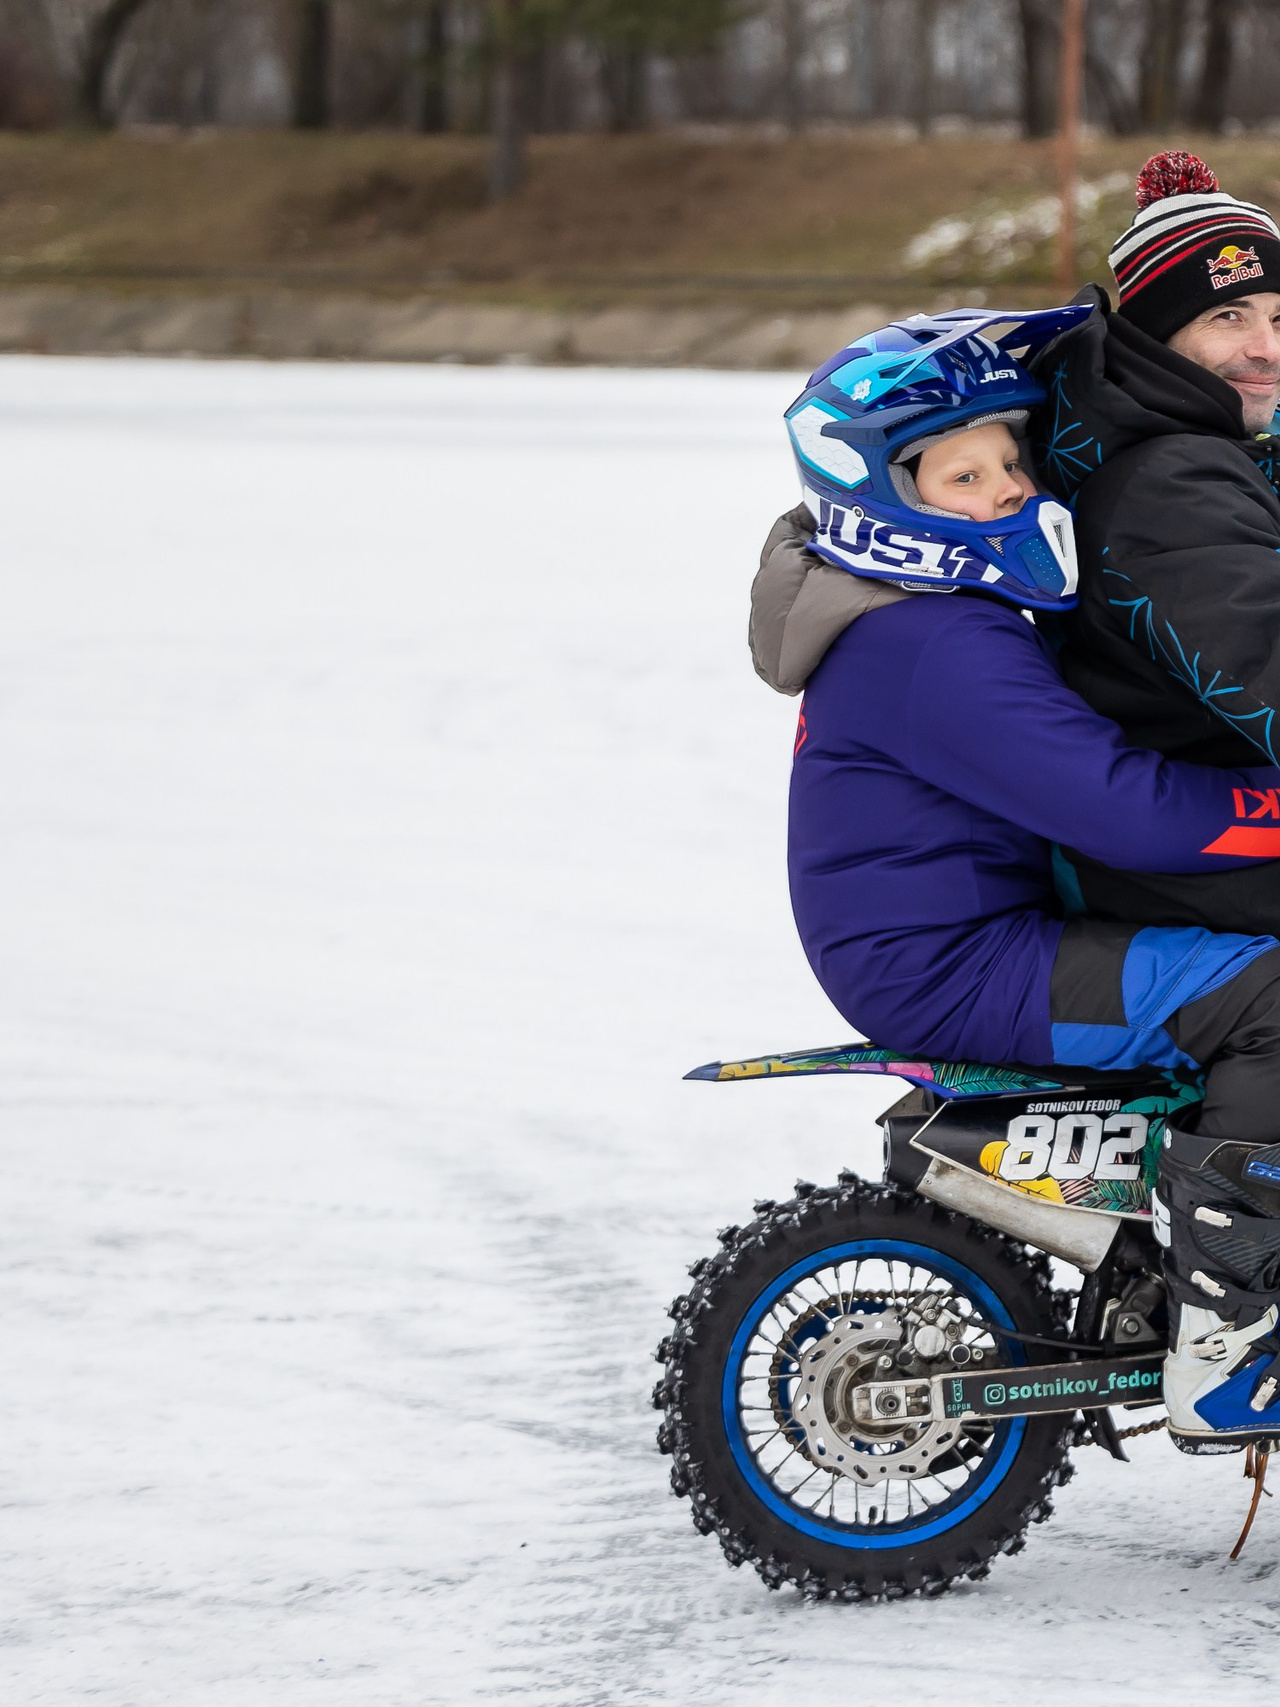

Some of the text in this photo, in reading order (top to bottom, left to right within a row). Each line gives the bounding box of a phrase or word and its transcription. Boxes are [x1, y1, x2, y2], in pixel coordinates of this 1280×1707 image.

[1211, 263, 1264, 289] Red Bull
[1026, 1099, 1122, 1113] SOTNIKOV FEDOR
[998, 1113, 1150, 1181] 802
[1009, 1369, 1162, 1400] sotnikov_fedor
